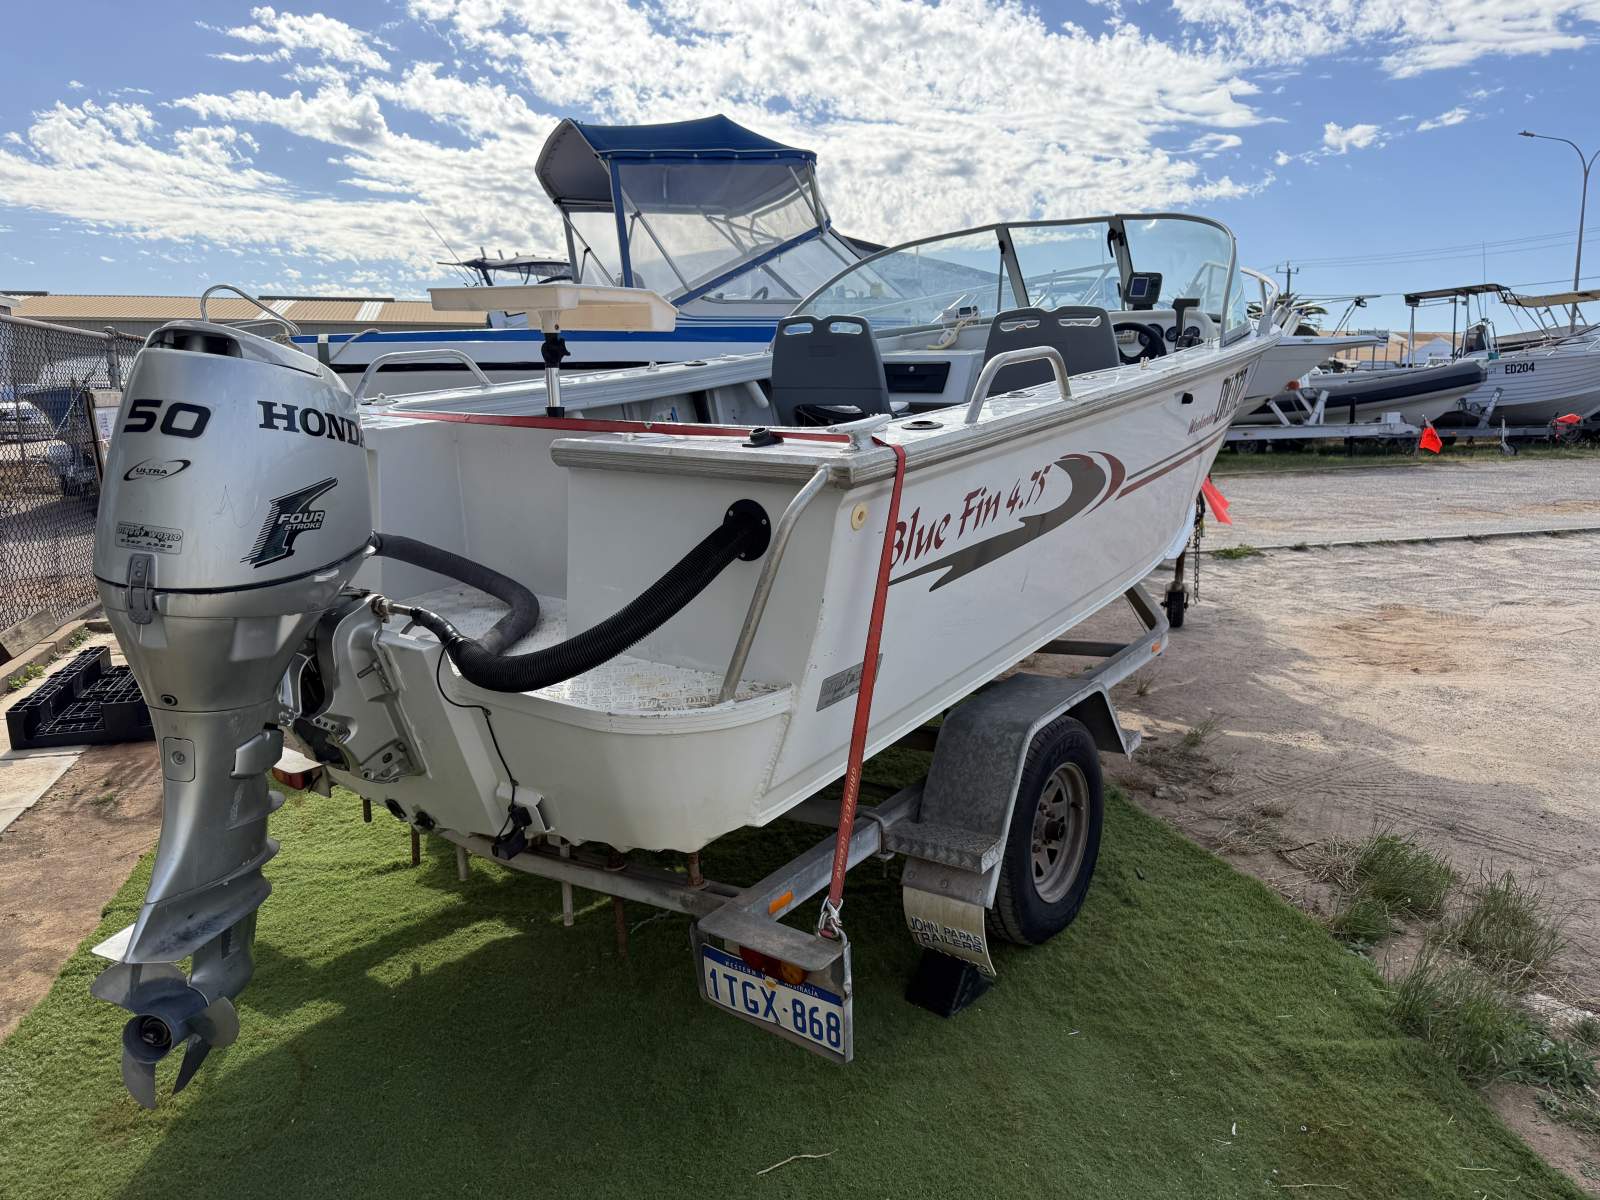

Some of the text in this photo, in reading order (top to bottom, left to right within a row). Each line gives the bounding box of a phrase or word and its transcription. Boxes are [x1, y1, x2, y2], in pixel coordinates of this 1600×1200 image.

[1504, 361, 1535, 374] ED204
[123, 398, 212, 439] 50
[135, 467, 168, 475] ULTRA
[277, 510, 325, 525] FOUR
[284, 521, 321, 531] STROKE
[891, 506, 952, 570] Blue
[957, 486, 1002, 539] Fin
[149, 529, 182, 542] WORLD
[910, 915, 983, 946] JOHN PAPAS
[911, 930, 984, 953] TRAILERS
